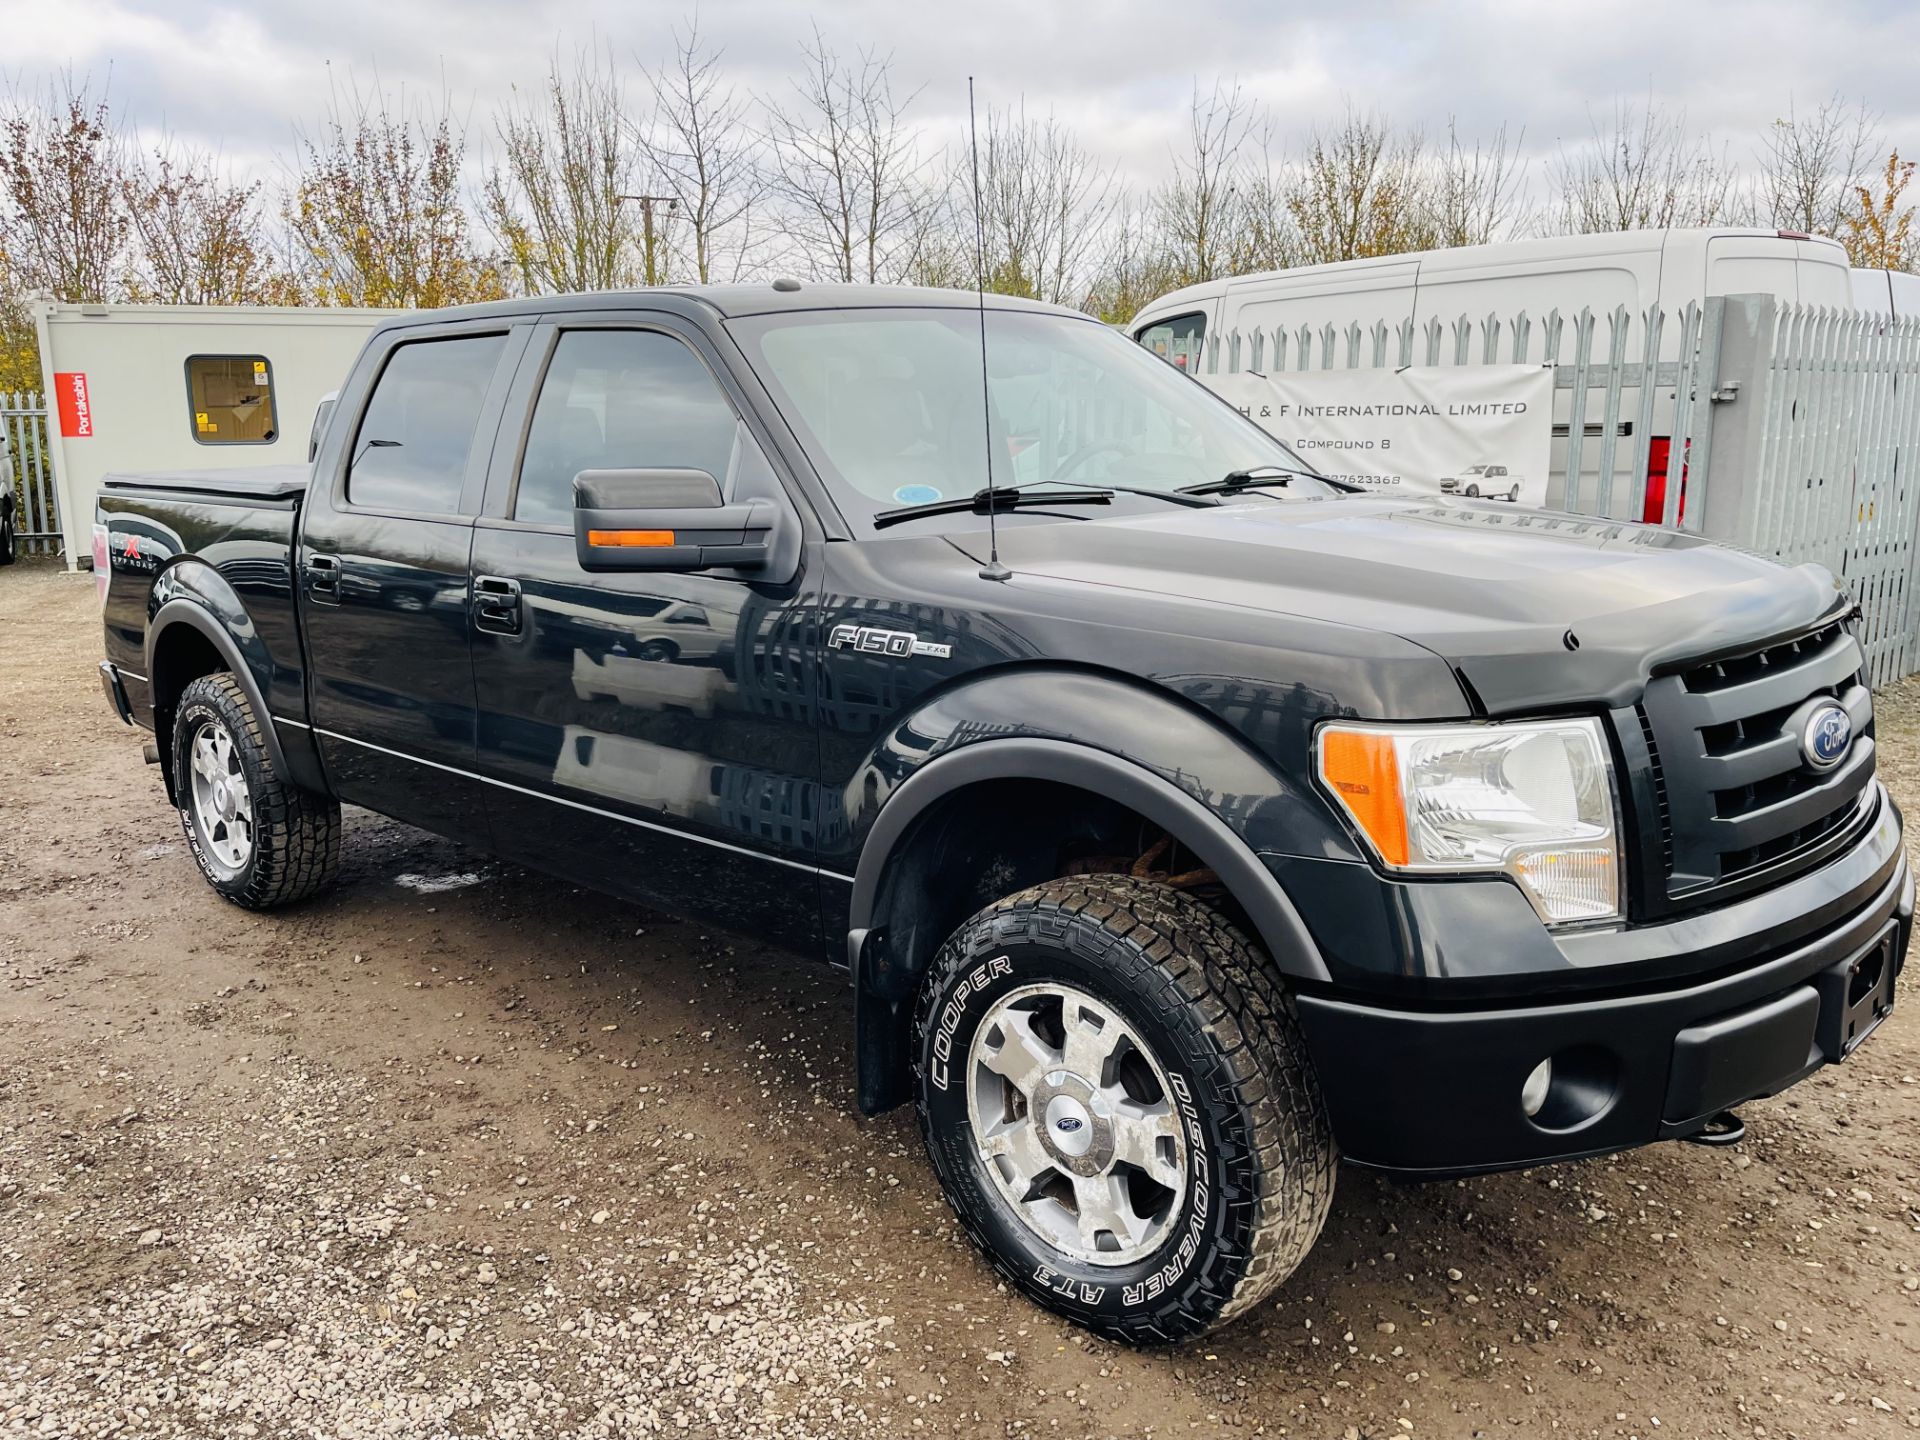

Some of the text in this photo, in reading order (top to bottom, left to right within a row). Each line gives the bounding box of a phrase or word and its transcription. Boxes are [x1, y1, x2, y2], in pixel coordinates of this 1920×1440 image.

[72, 375, 91, 435] Portakabin
[1260, 405, 1272, 417] &
[1280, 405, 1290, 417] F
[1297, 404, 1441, 418] INTERNATIONAL
[1449, 402, 1528, 416] LIMITED
[1297, 439, 1375, 450] COMPOUND
[112, 555, 153, 570] OFF ROAD
[828, 624, 917, 657] F-150
[931, 955, 1014, 1091] COOPER
[1122, 1071, 1210, 1307] DISCOVERER
[1032, 1264, 1106, 1305] AT3
